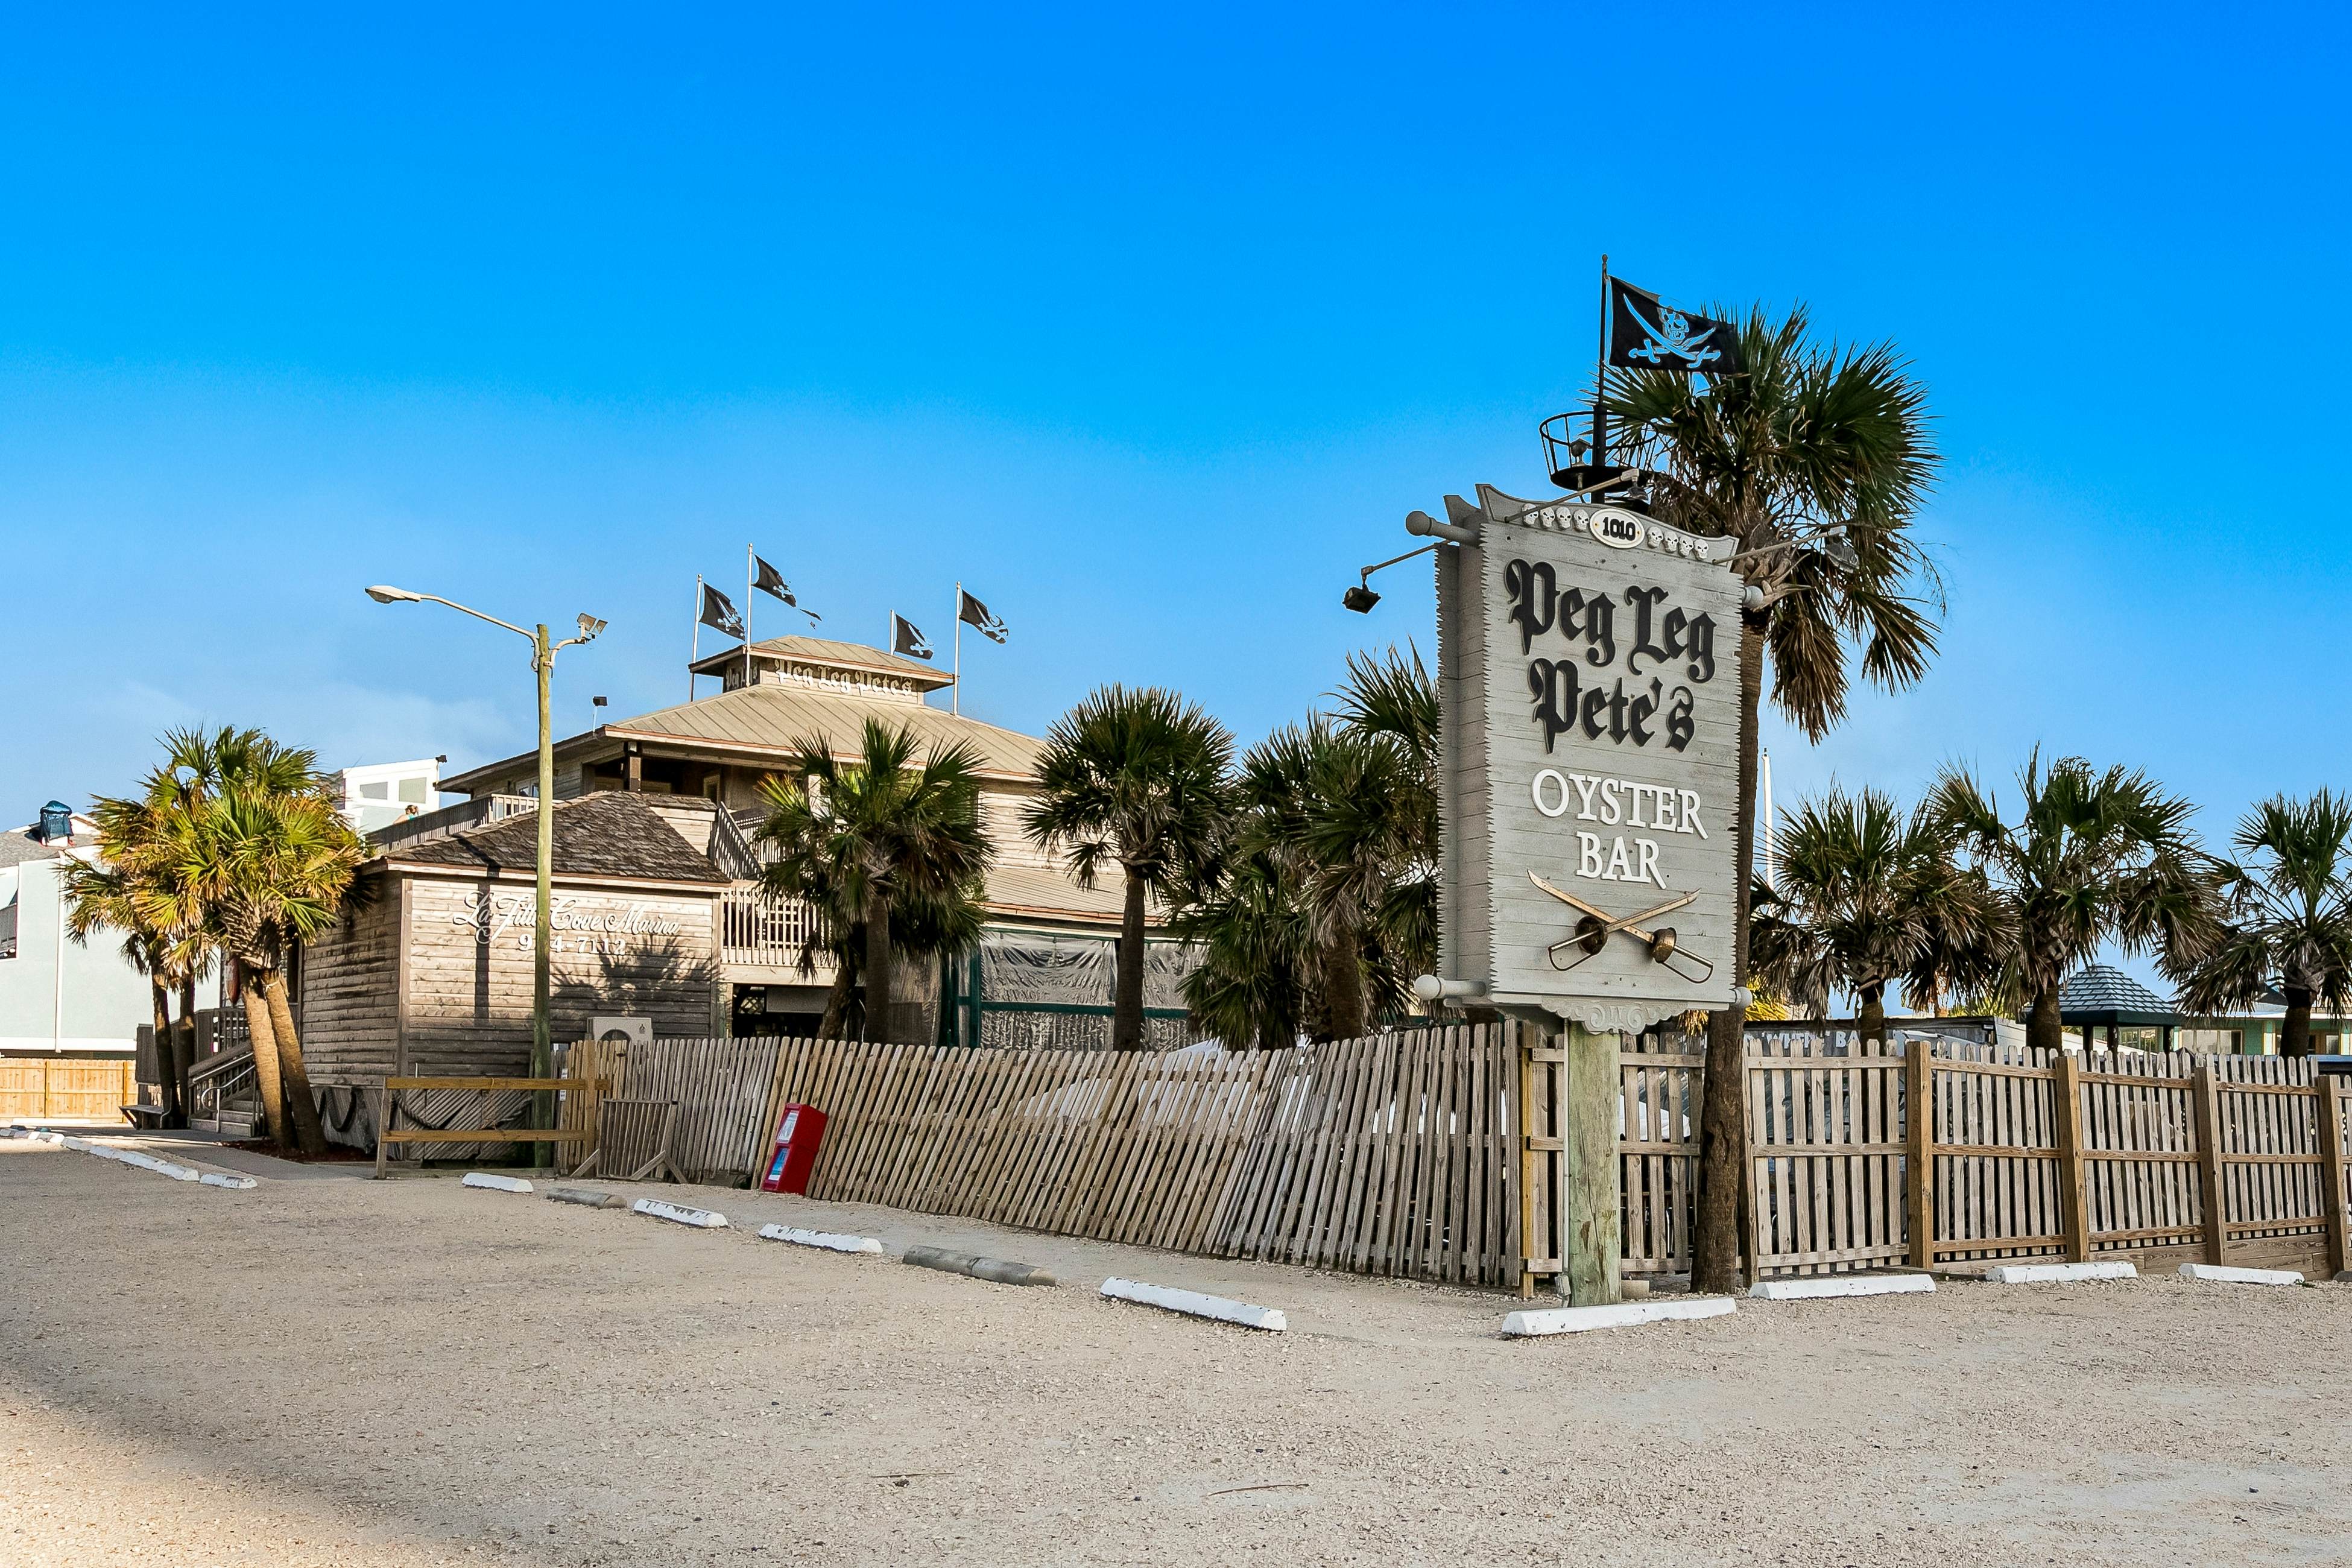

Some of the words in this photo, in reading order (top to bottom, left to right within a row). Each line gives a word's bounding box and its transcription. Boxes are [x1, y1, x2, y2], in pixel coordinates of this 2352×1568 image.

[1602, 516, 1636, 542] 1010
[1504, 558, 1616, 667] Peg
[1624, 585, 1718, 683] Leg
[774, 658, 814, 689] Peg
[817, 665, 852, 694] Leg
[855, 671, 912, 696] Pete's
[1527, 657, 1695, 754] Pete's
[1531, 768, 1709, 840] OYSTER
[1575, 830, 1667, 890] BAR
[549, 896, 602, 931] Cove
[604, 905, 681, 935] Marina
[518, 934, 627, 956] 94-7112
